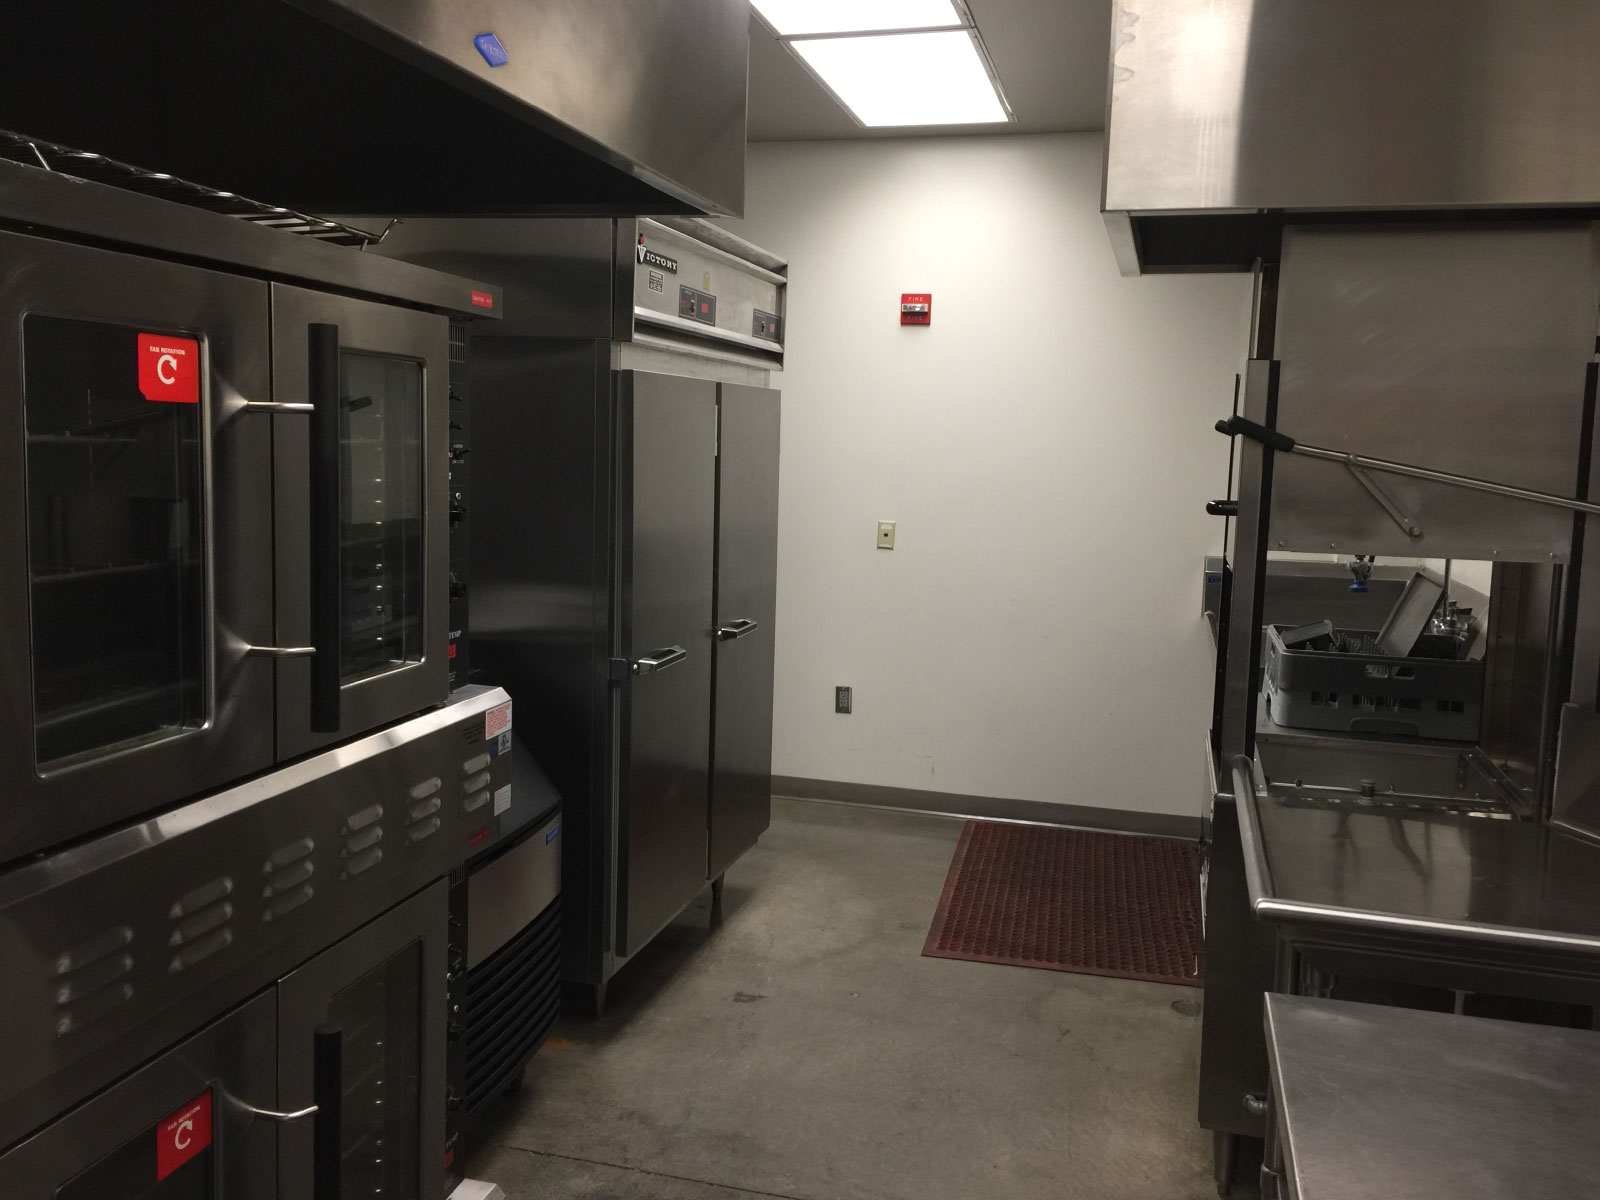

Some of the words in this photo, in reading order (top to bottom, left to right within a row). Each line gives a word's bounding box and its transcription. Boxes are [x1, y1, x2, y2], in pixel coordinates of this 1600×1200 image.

[637, 244, 678, 271] VICTORY
[149, 345, 160, 353] FAN
[161, 347, 185, 355] ROTATION
